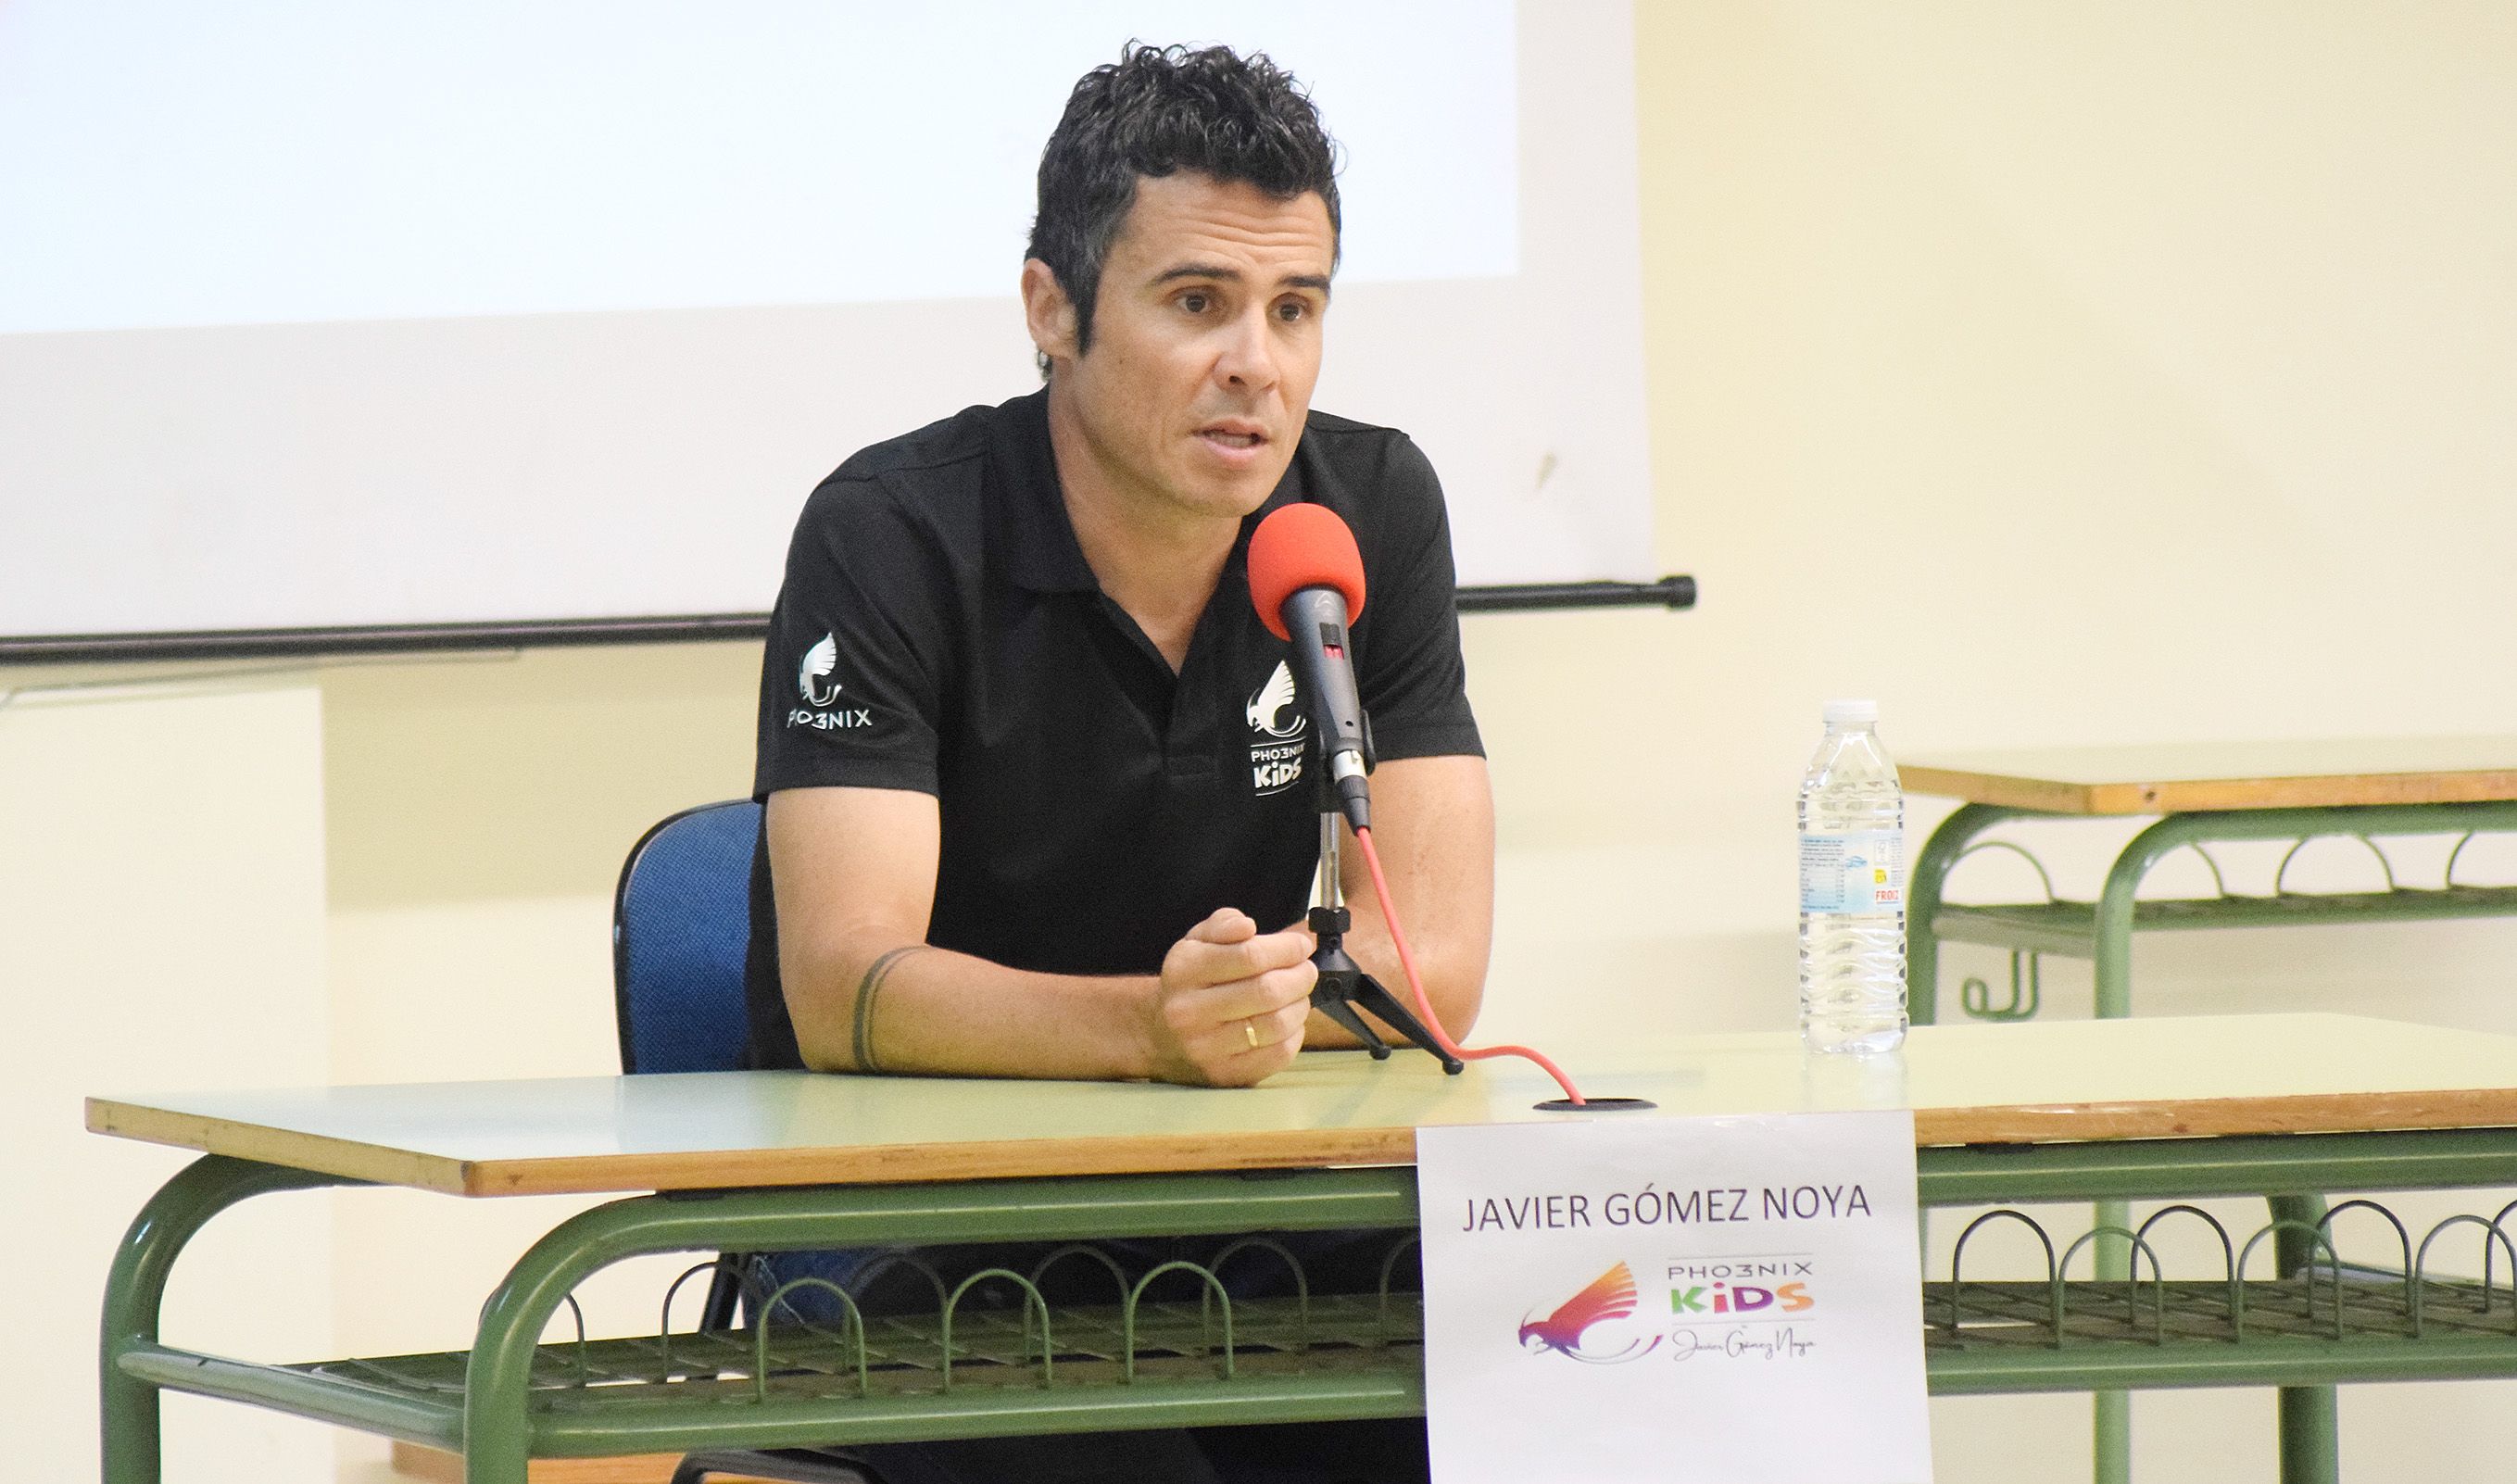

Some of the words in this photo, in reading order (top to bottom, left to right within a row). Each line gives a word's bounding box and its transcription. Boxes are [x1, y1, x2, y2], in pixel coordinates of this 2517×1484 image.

[1463, 1194, 1591, 1232] JAVIER
[1604, 1183, 1749, 1226] GÓMEZ
[1763, 1185, 1871, 1221] NOYA
[1668, 1262, 1813, 1280] PHO3NIX
